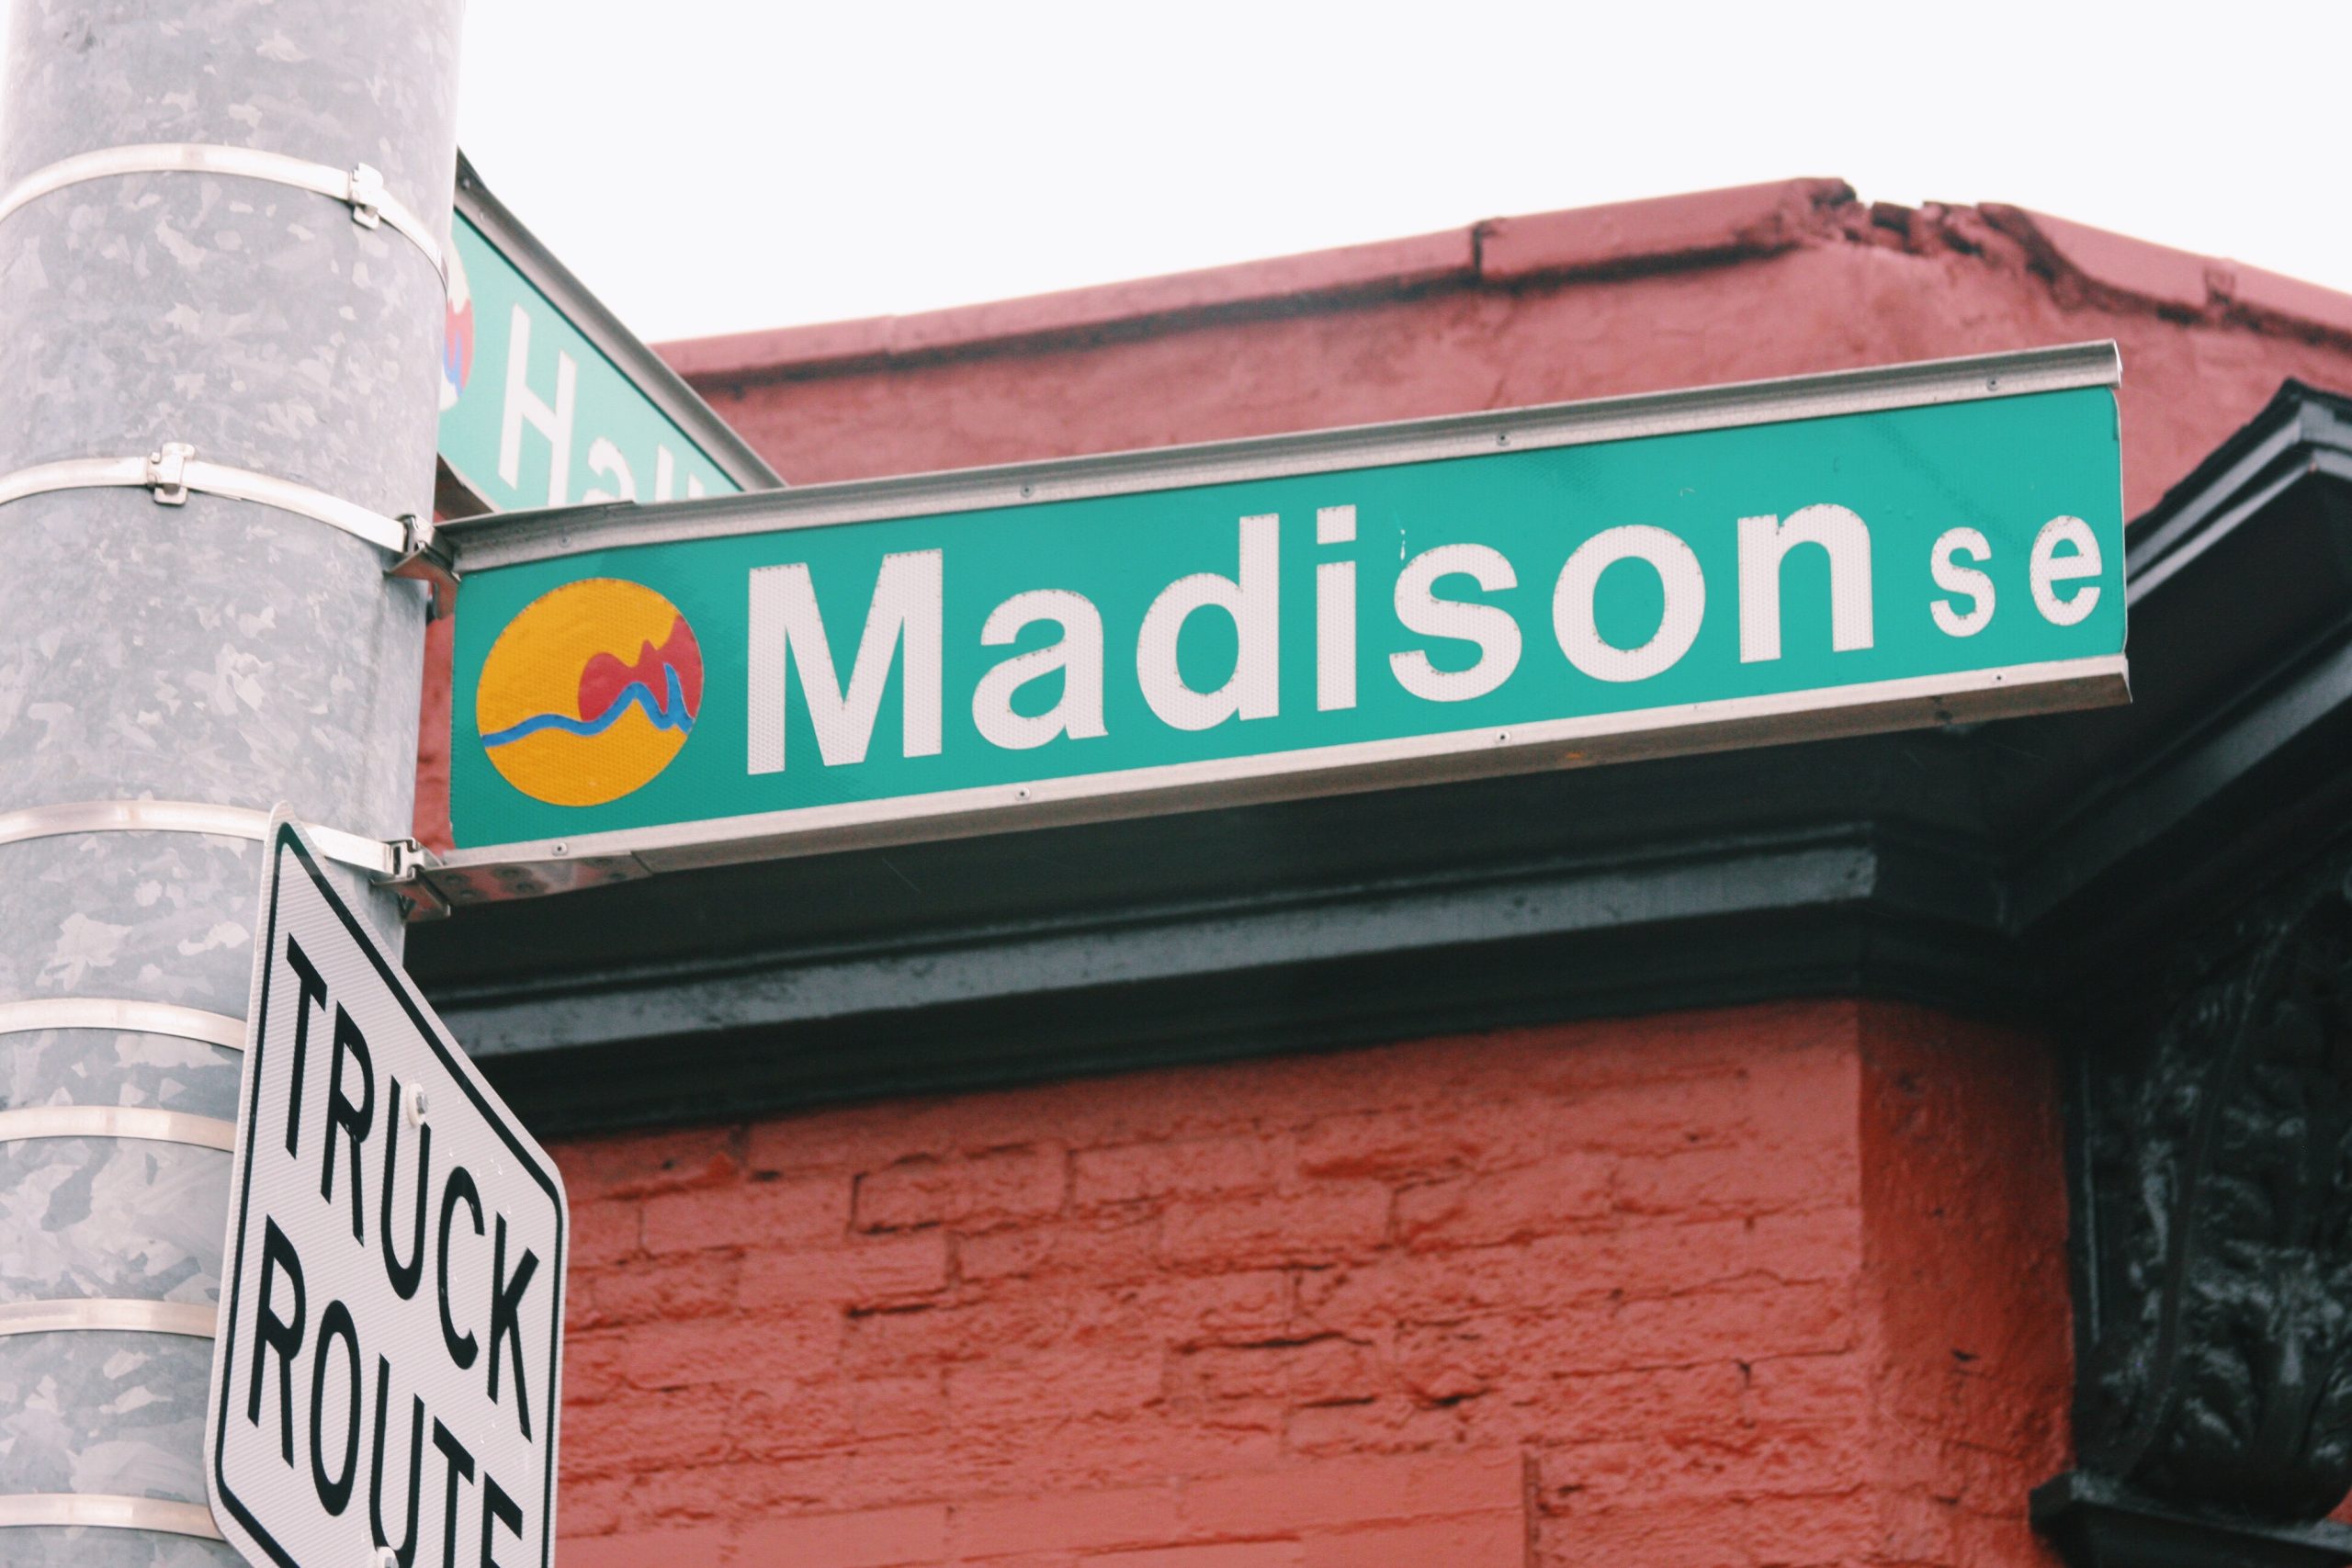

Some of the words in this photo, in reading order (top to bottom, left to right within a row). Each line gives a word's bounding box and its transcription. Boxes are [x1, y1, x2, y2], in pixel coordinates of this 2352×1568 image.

[746, 502, 1874, 775] Madison
[1929, 513, 2103, 638] se
[285, 931, 539, 1443] TRUCK
